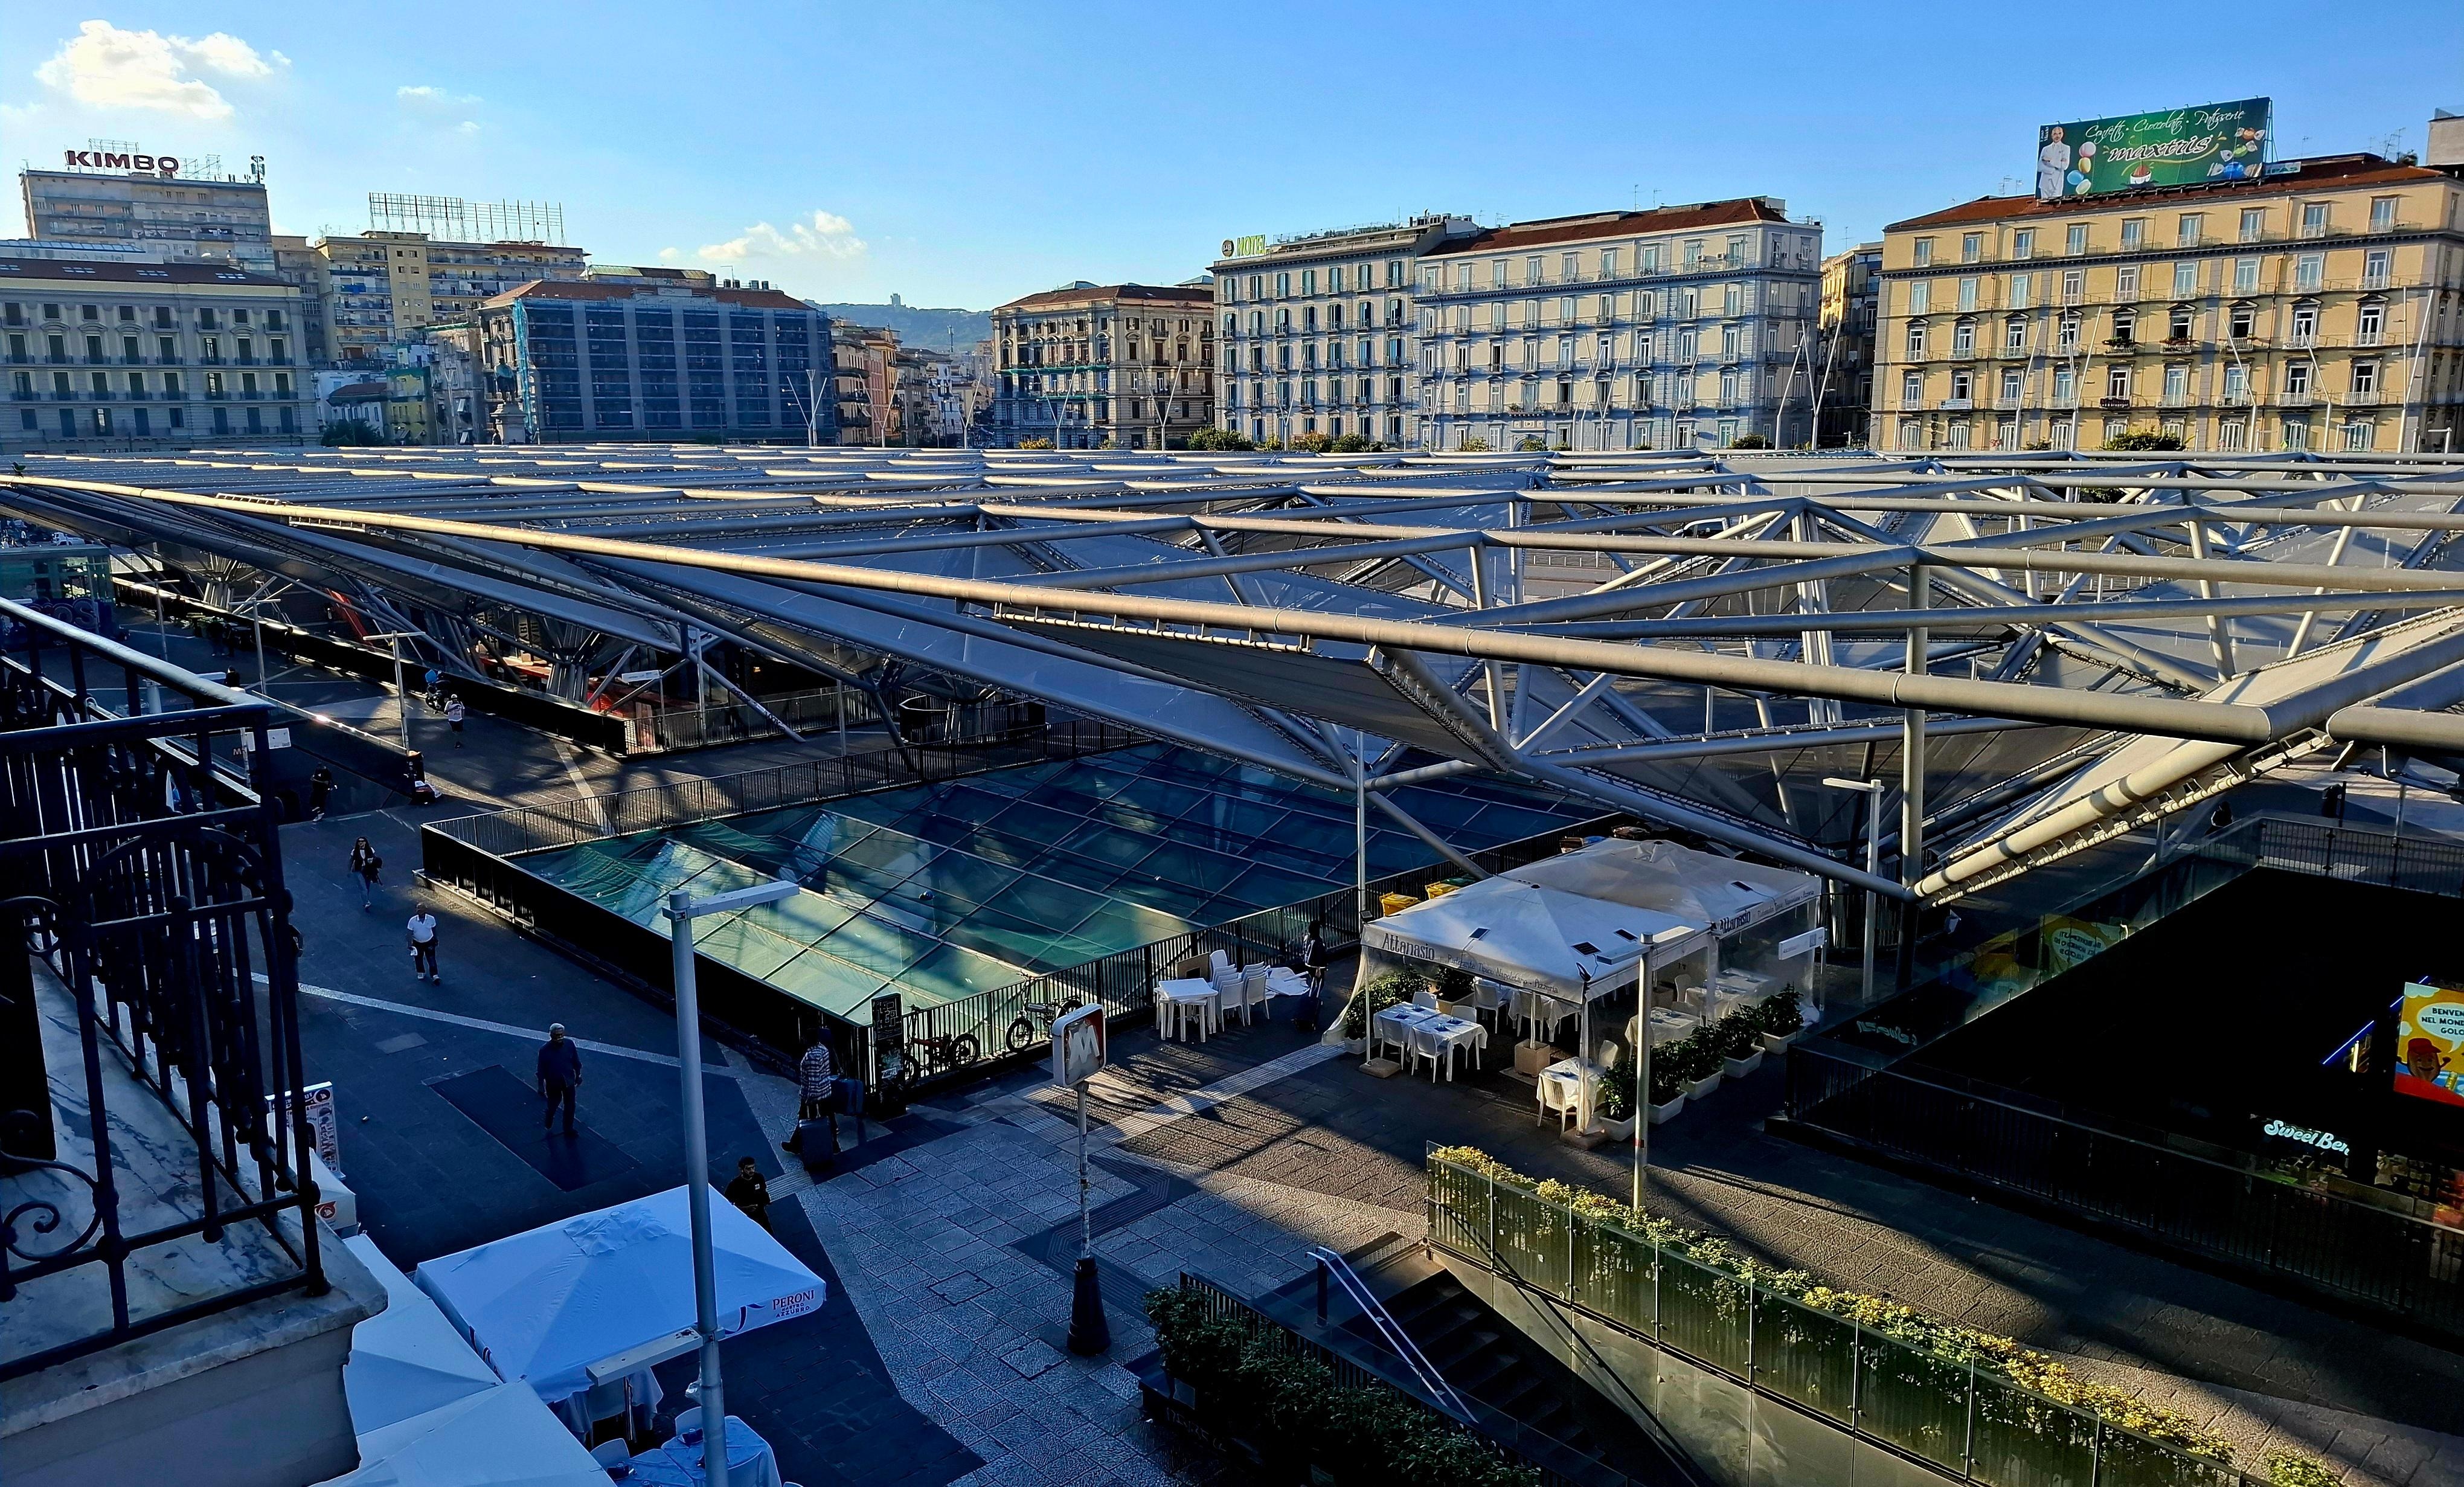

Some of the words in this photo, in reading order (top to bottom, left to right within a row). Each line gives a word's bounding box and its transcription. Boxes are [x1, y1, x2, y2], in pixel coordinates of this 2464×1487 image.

[2106, 135, 2211, 163] maxtris
[67, 150, 179, 172] KIMBO
[1236, 234, 1266, 257] HOTEL
[1930, 413, 1939, 451] HOTE
[1381, 932, 1436, 961] Attanasio
[2440, 1027, 2464, 1036] GOLO
[2264, 1119, 2319, 1145] Sweet
[772, 1289, 814, 1310] PERONI
[775, 1305, 810, 1318] AZZURRO
